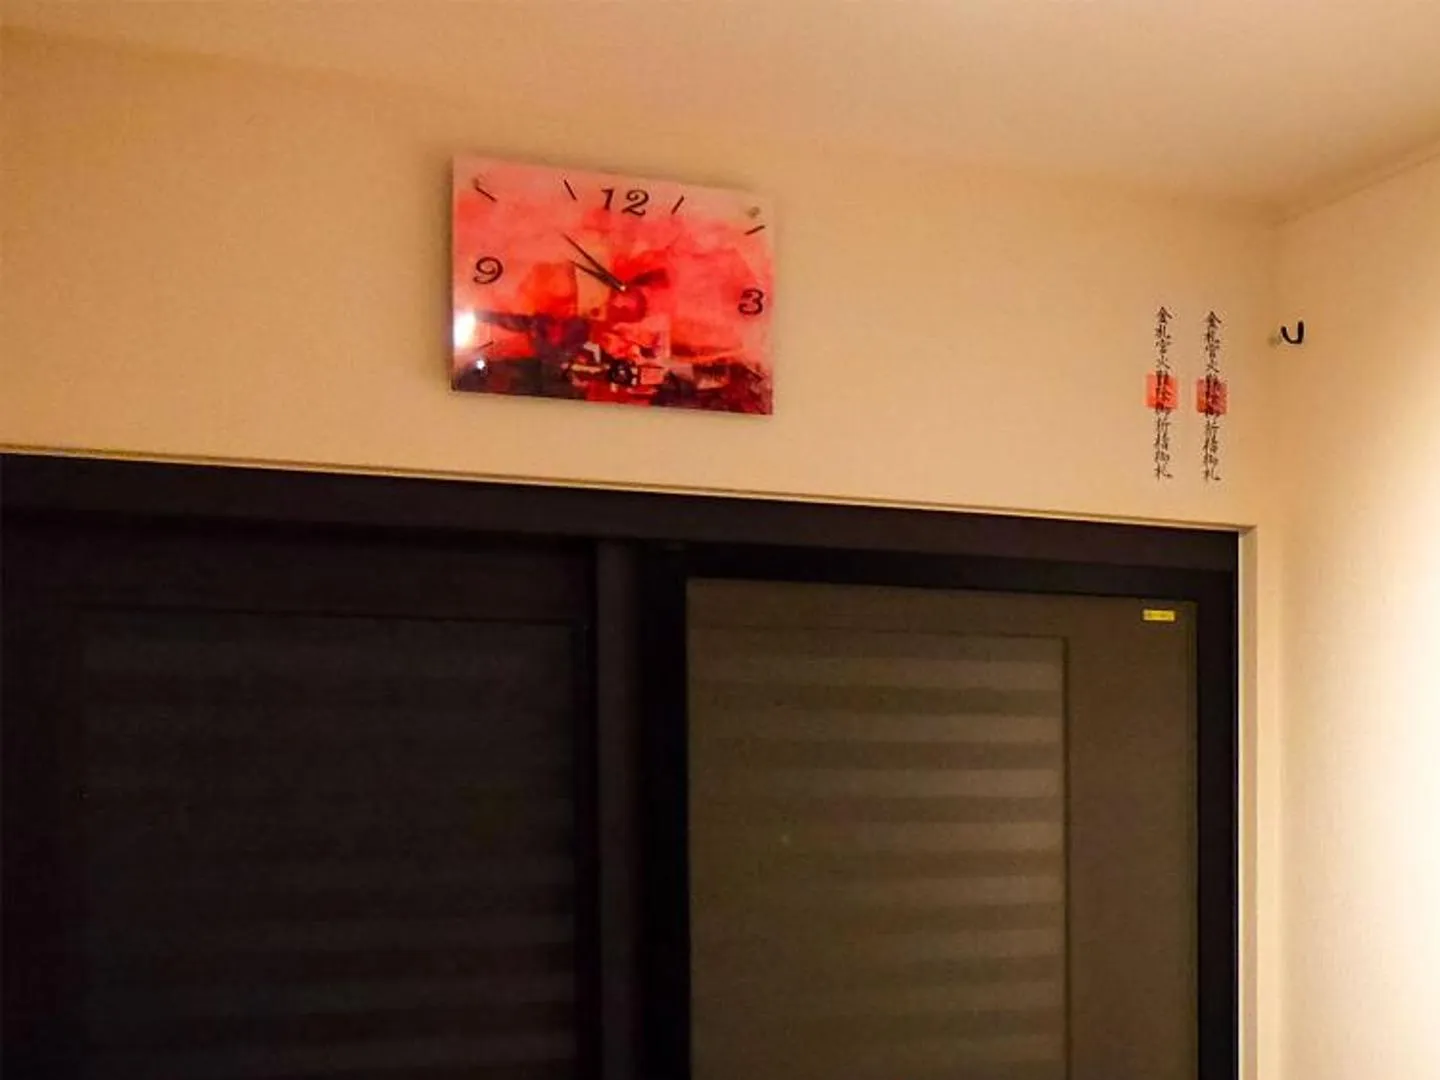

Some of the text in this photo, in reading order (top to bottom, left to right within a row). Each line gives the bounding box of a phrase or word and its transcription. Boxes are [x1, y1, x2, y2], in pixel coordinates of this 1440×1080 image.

[600, 188, 650, 217] 12
[473, 257, 504, 285] 9
[738, 289, 765, 316] 3
